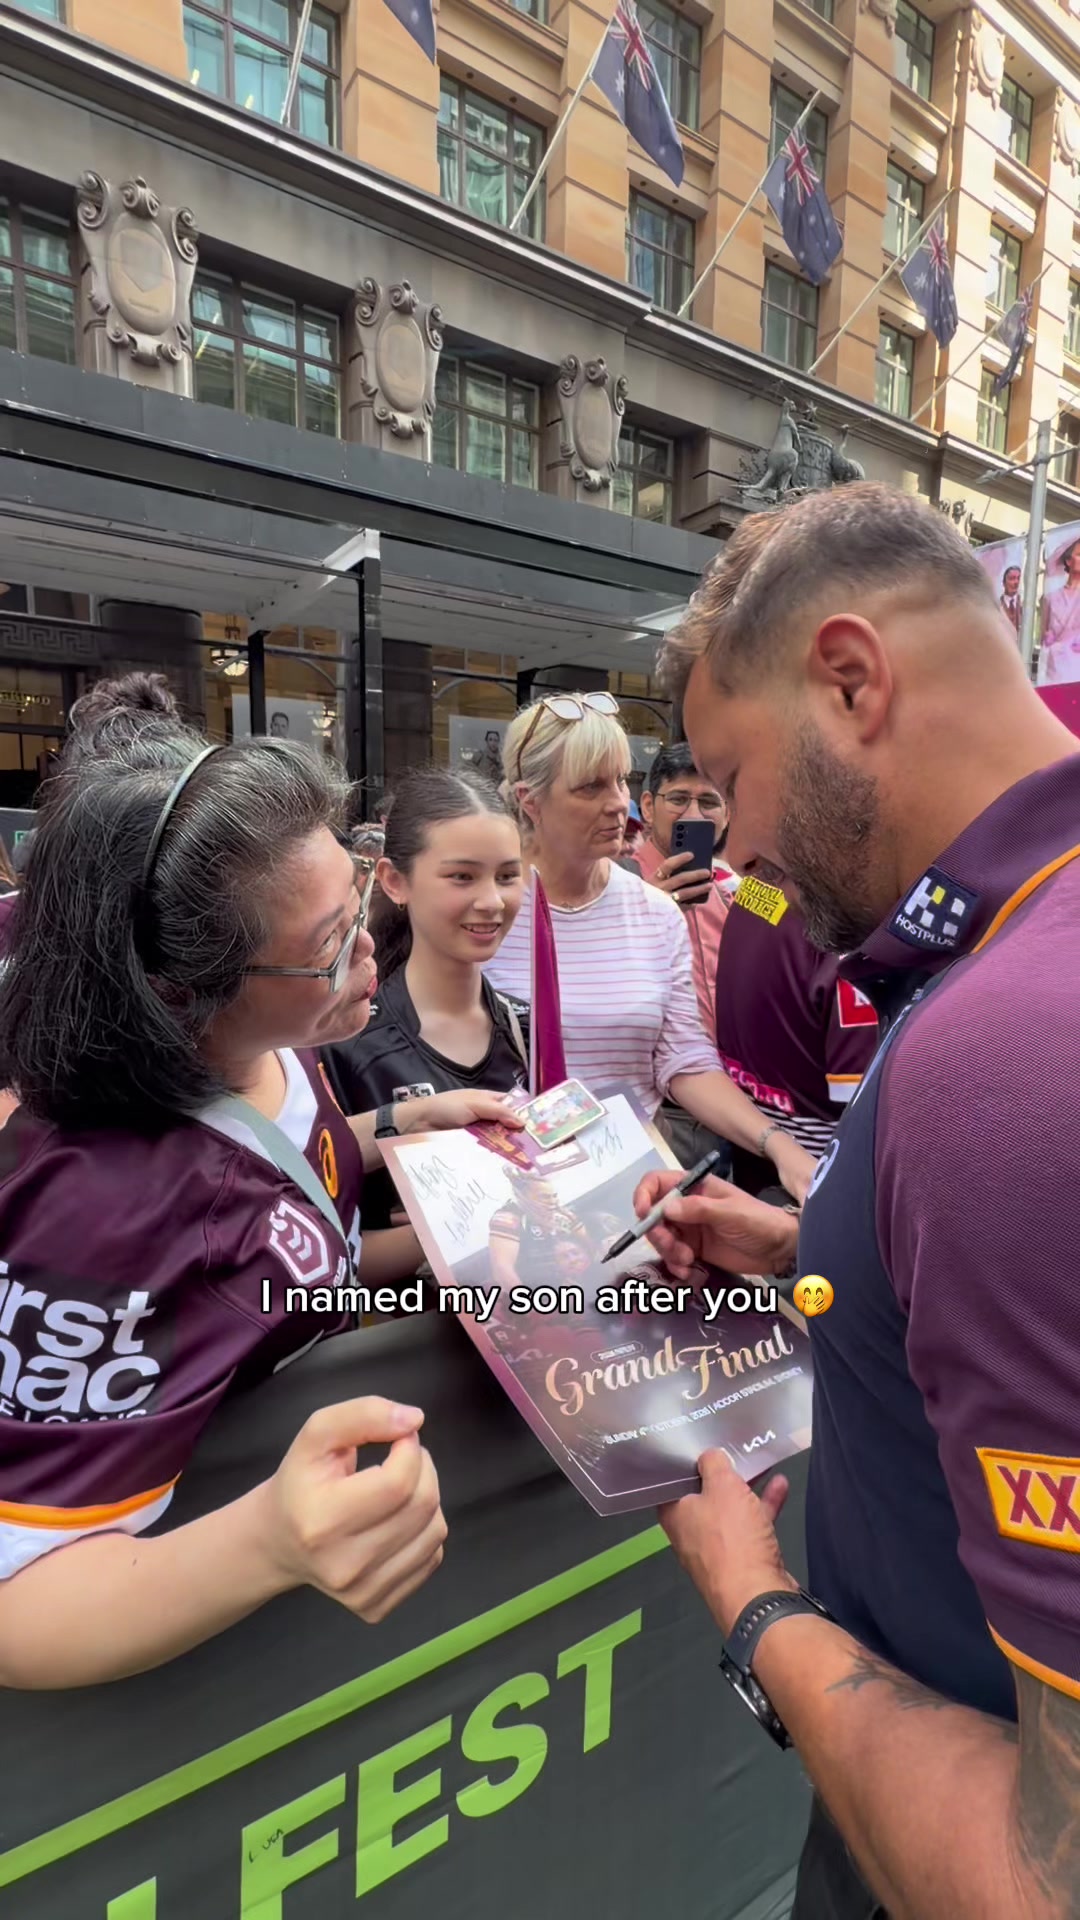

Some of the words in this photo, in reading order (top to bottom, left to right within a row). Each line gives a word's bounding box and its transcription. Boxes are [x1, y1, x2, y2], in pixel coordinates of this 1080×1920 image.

[895, 914, 956, 946] HOSTPLUS
[545, 1336, 679, 1416] Grand
[675, 1323, 794, 1401] Final
[241, 1608, 642, 1920] FEST
